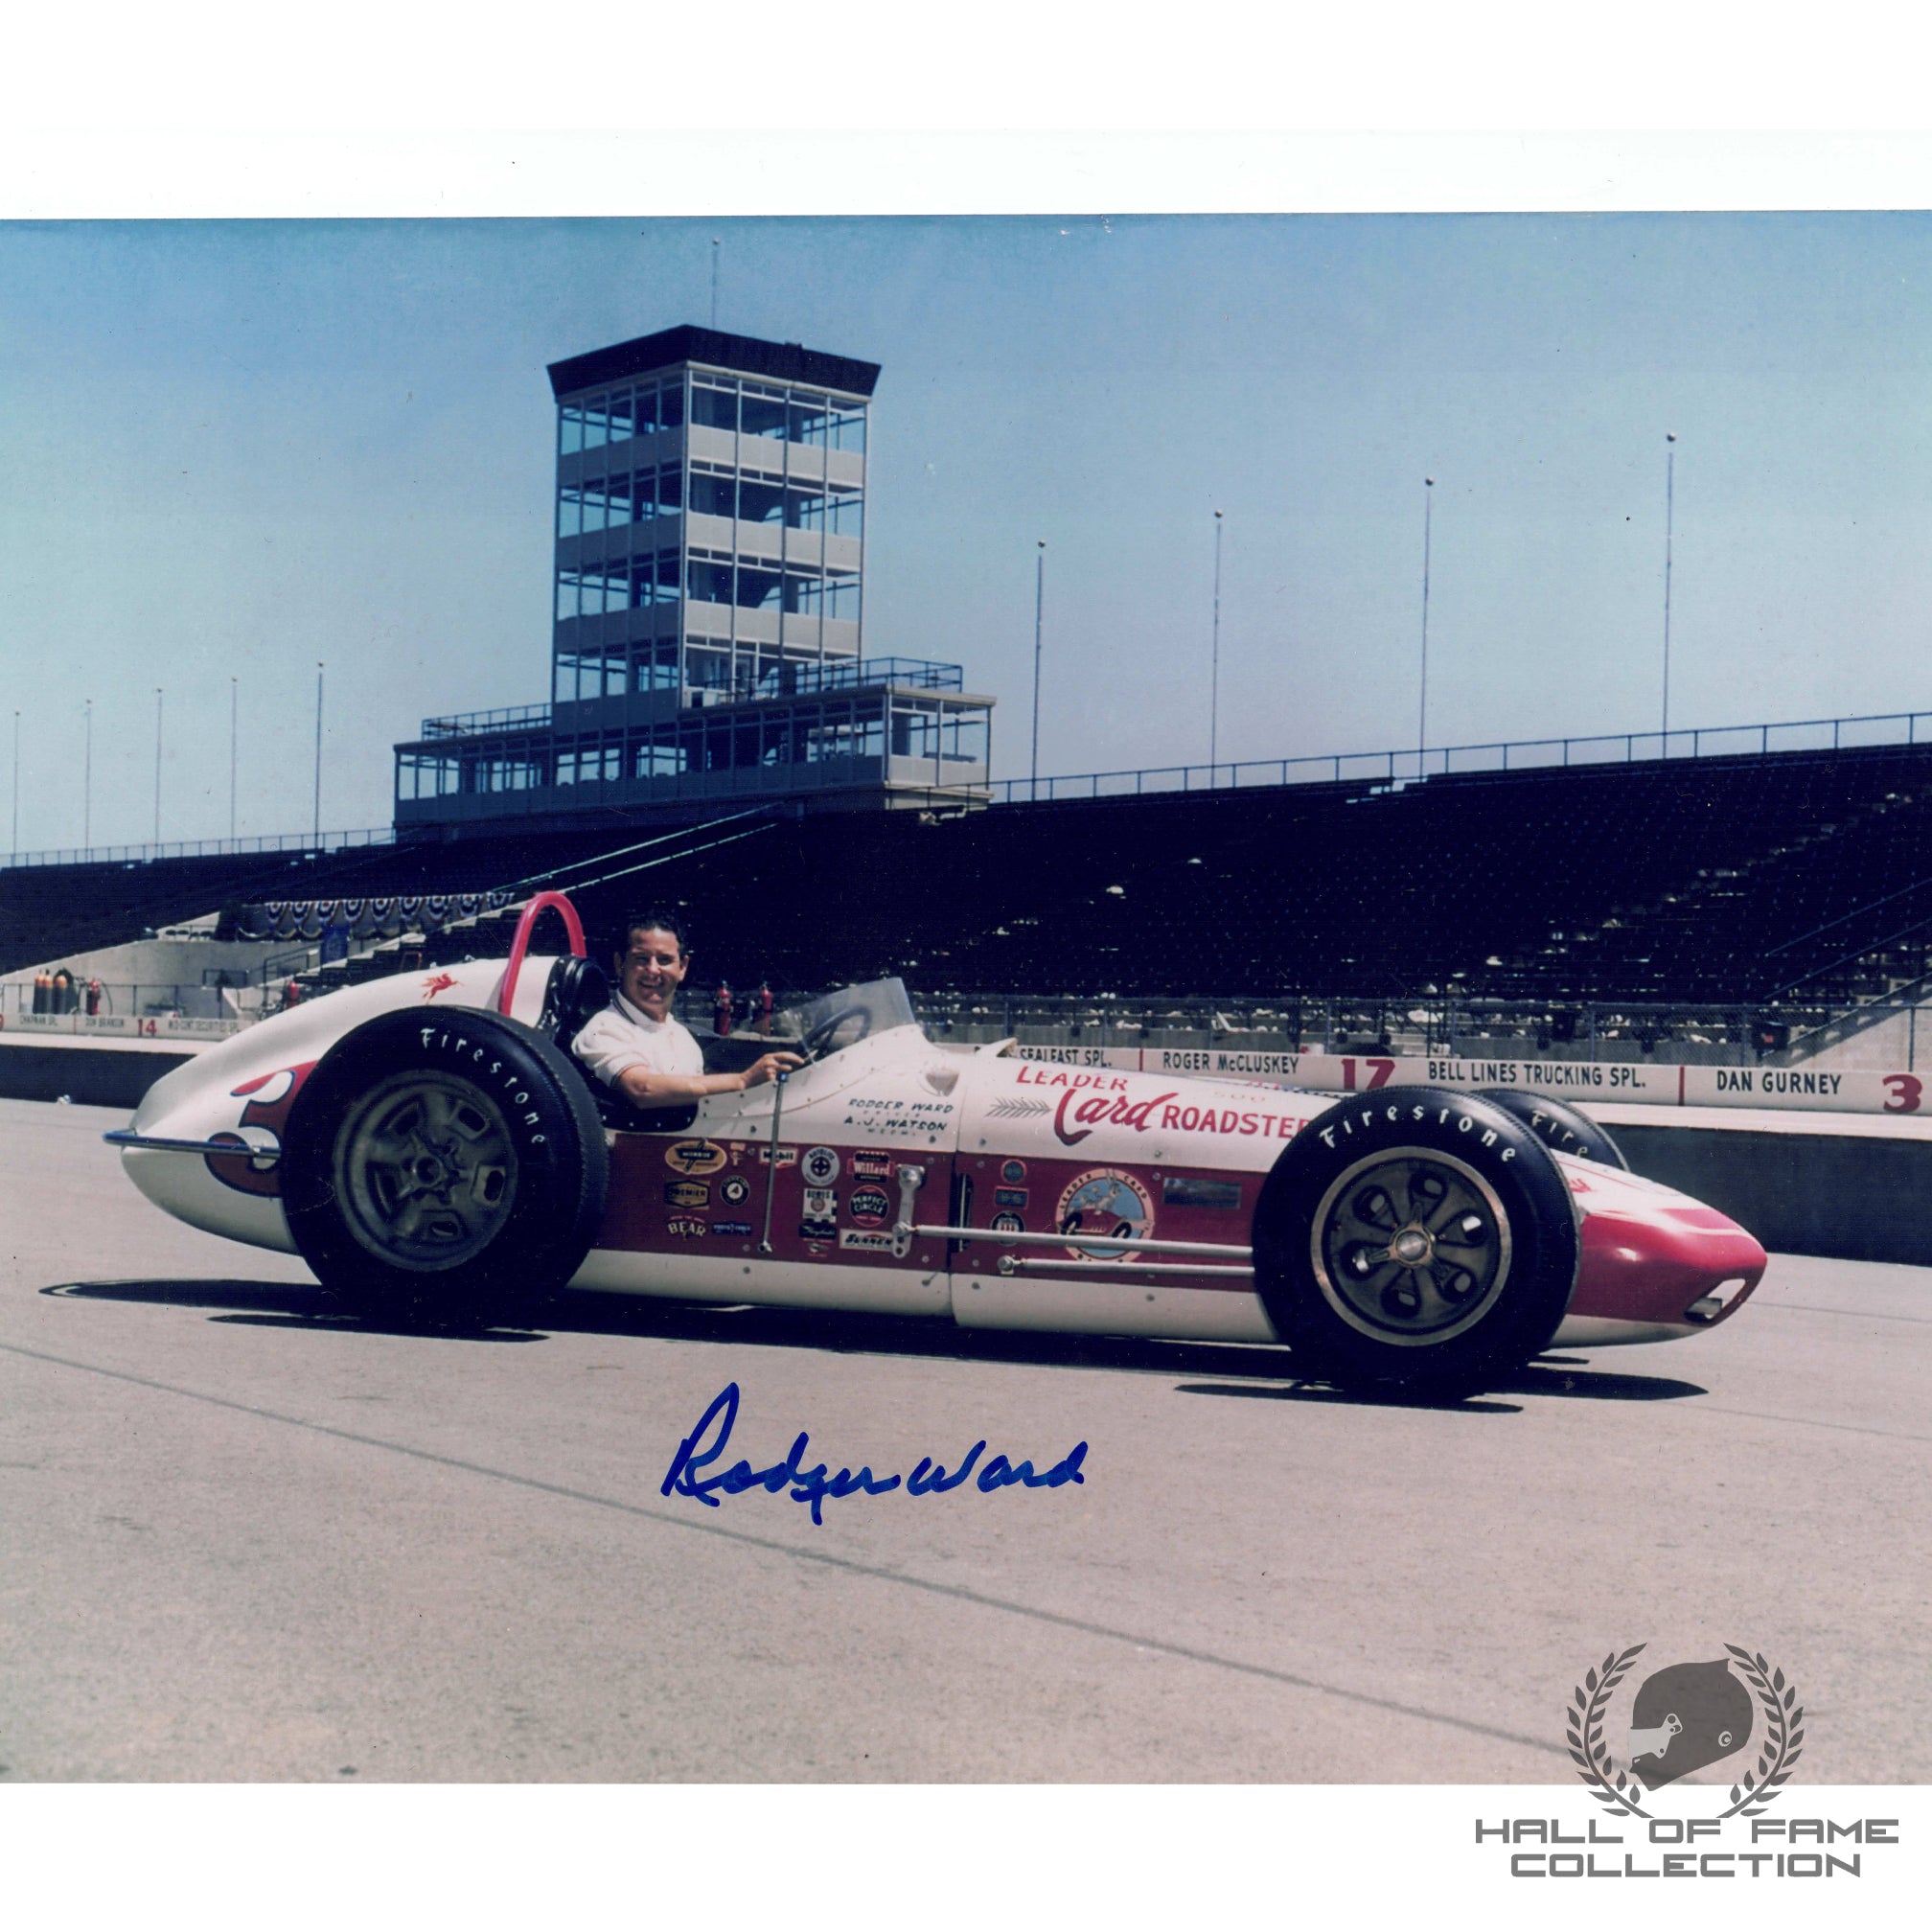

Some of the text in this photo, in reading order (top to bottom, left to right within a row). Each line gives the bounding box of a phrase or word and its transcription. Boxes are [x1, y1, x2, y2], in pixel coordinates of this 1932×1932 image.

[137, 1019, 157, 1037] 14
[1085, 1049, 1112, 1068] SPL.
[1163, 1051, 1299, 1074] ROGER McCLUSKEY
[421, 1028, 545, 1143] Firestone
[1016, 1066, 1128, 1092] LEADER
[1342, 1059, 1395, 1090] 17
[1429, 1061, 1645, 1088] BELL LINES TRUCKING SPL.
[1716, 1070, 1841, 1094] DAN GURNEY
[1882, 1073, 1923, 1114] 3
[911, 1103, 954, 1114] WARD
[1054, 1092, 1179, 1146] Card
[886, 1119, 948, 1131] WATSON
[1320, 1105, 1515, 1162] Firestone
[763, 1150, 794, 1161] Mbil
[854, 1162, 889, 1175] Willard
[668, 1222, 706, 1237] BEAR
